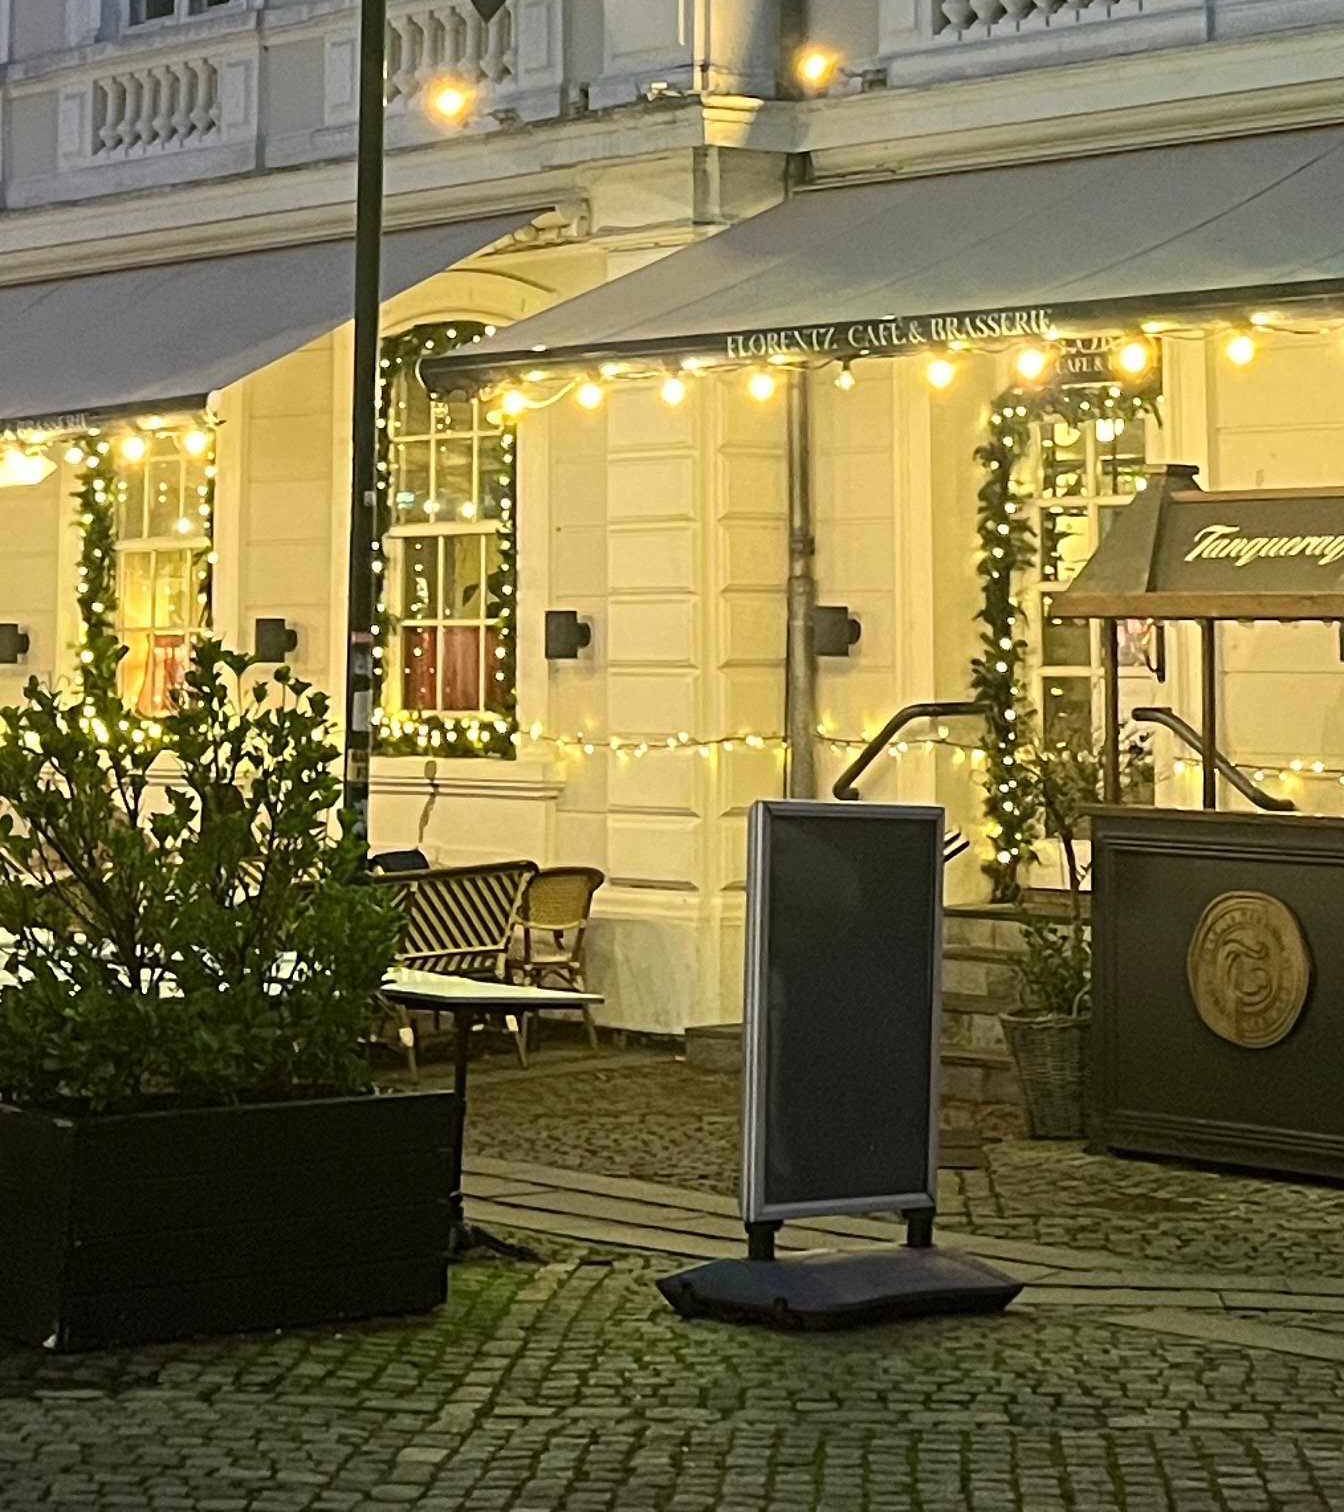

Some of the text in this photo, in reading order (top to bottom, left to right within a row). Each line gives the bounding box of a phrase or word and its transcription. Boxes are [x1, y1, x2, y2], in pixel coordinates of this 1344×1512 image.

[726, 326, 838, 359] FLORENTZ
[908, 320, 928, 344] &
[931, 308, 1056, 341] BRASSERIE
